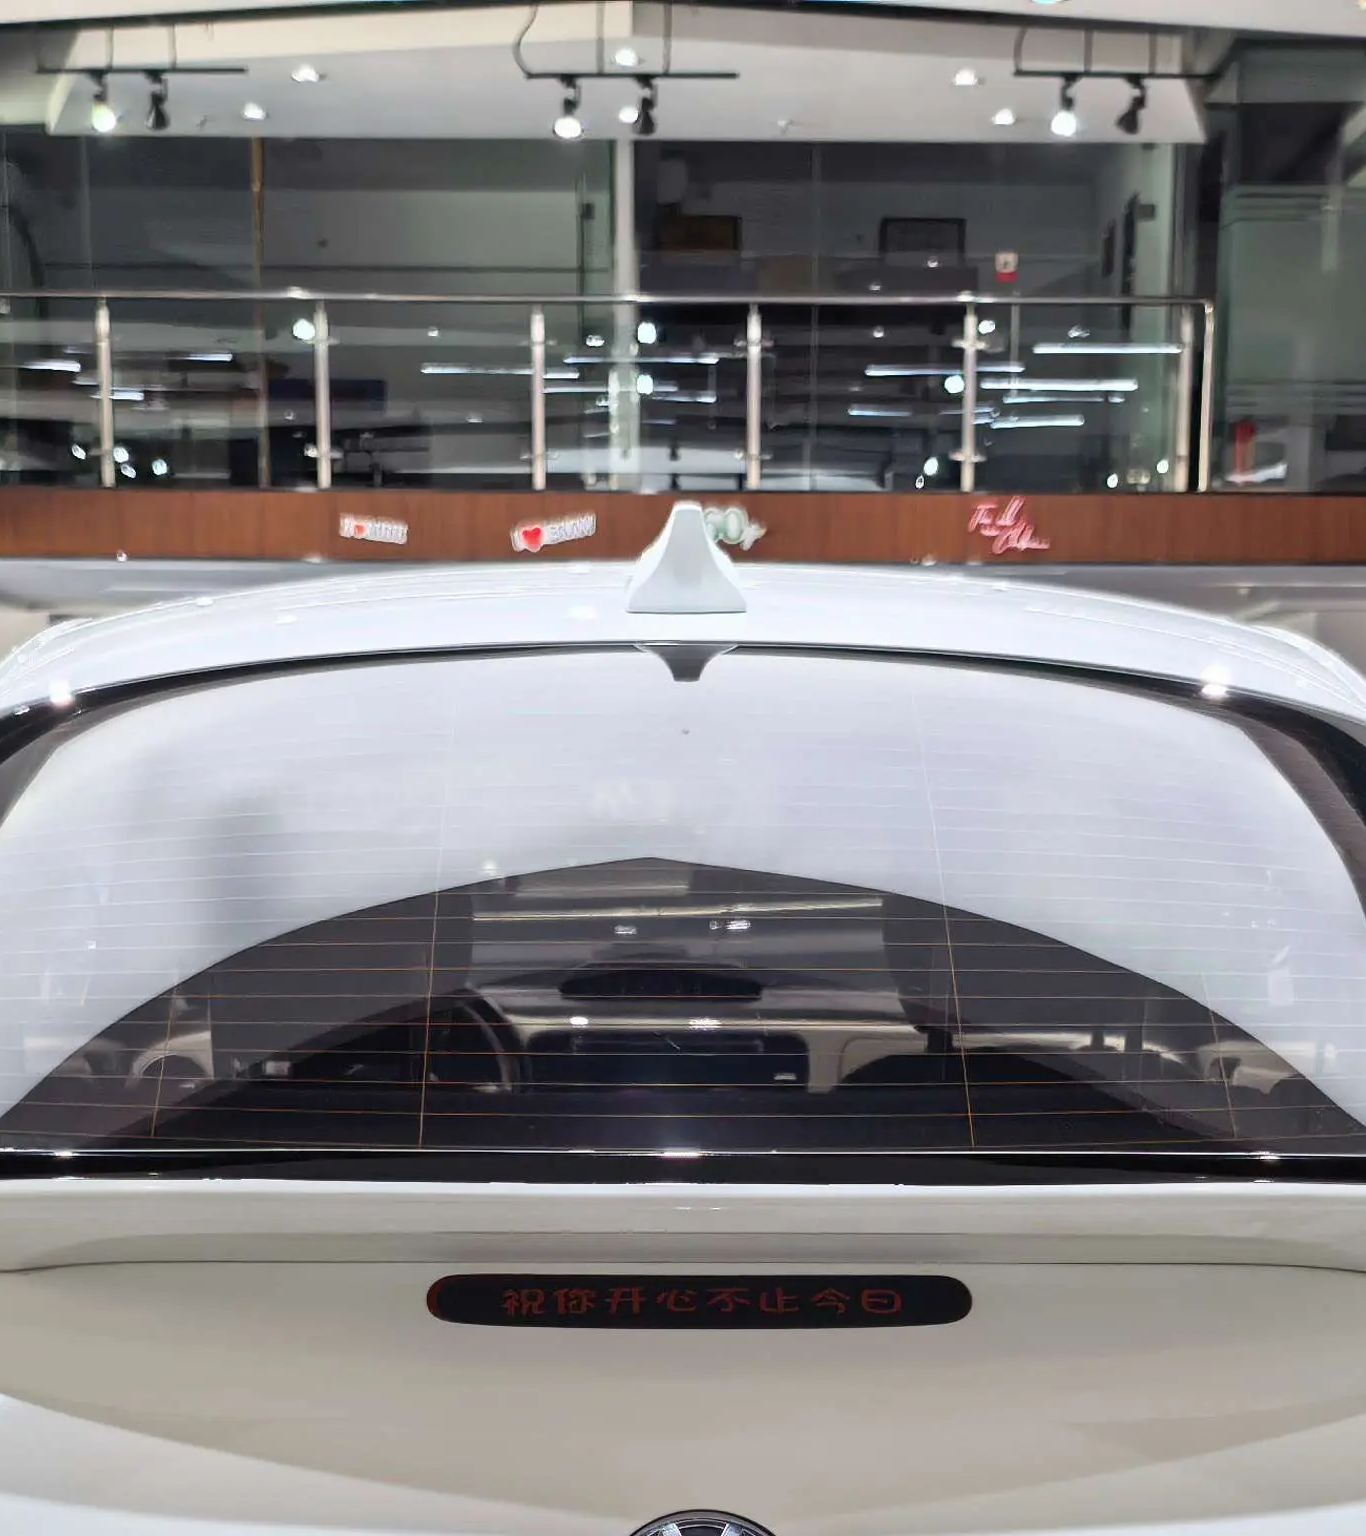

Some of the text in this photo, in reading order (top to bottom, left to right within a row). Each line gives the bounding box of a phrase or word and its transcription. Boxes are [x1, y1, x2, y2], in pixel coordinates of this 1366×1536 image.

[502, 1287, 902, 1316] 祝你开心不止今日
